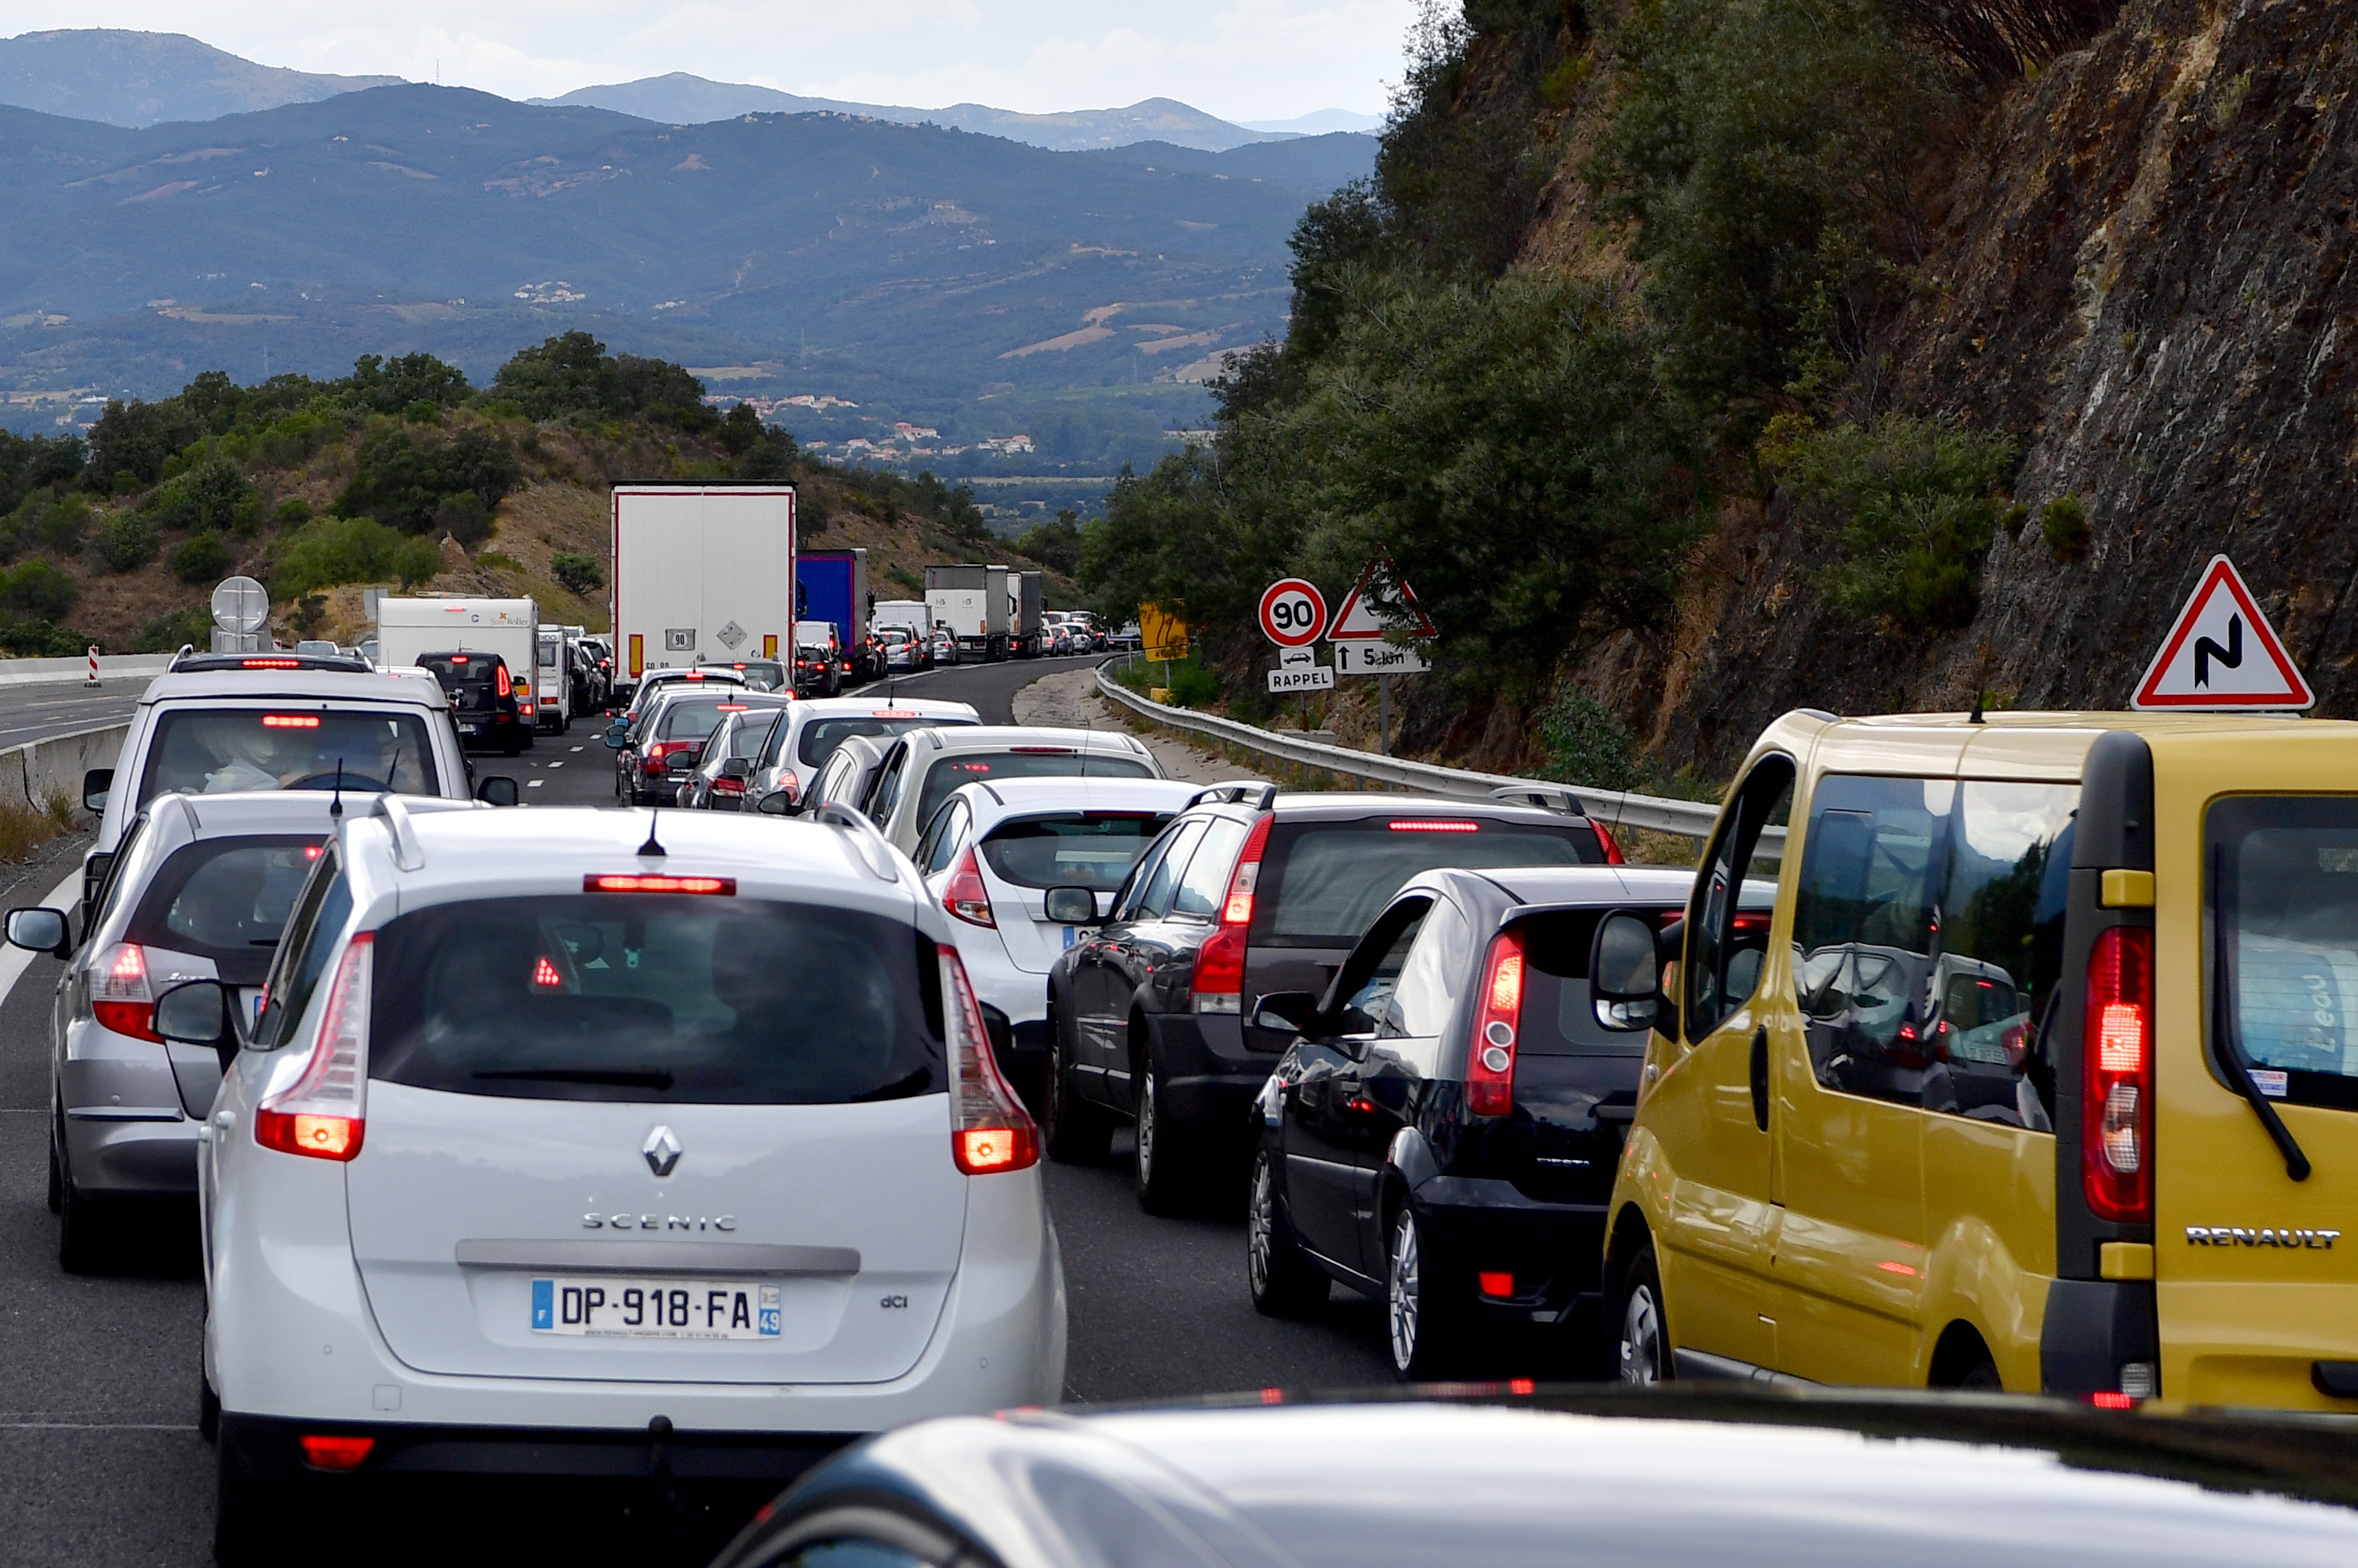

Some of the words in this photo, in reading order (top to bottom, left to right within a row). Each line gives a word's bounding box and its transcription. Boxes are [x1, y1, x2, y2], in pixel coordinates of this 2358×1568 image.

[507, 617, 529, 625] Roller
[1273, 600, 1314, 629] 90
[675, 634, 685, 646] 90
[1364, 648, 1375, 666] 5
[1273, 672, 1329, 687] RAPPEL
[582, 1212, 738, 1232] SCENIC
[2185, 1226, 2341, 1249] RENAULT
[562, 1286, 750, 1330] DP-918-FA
[759, 1313, 780, 1331] 49
